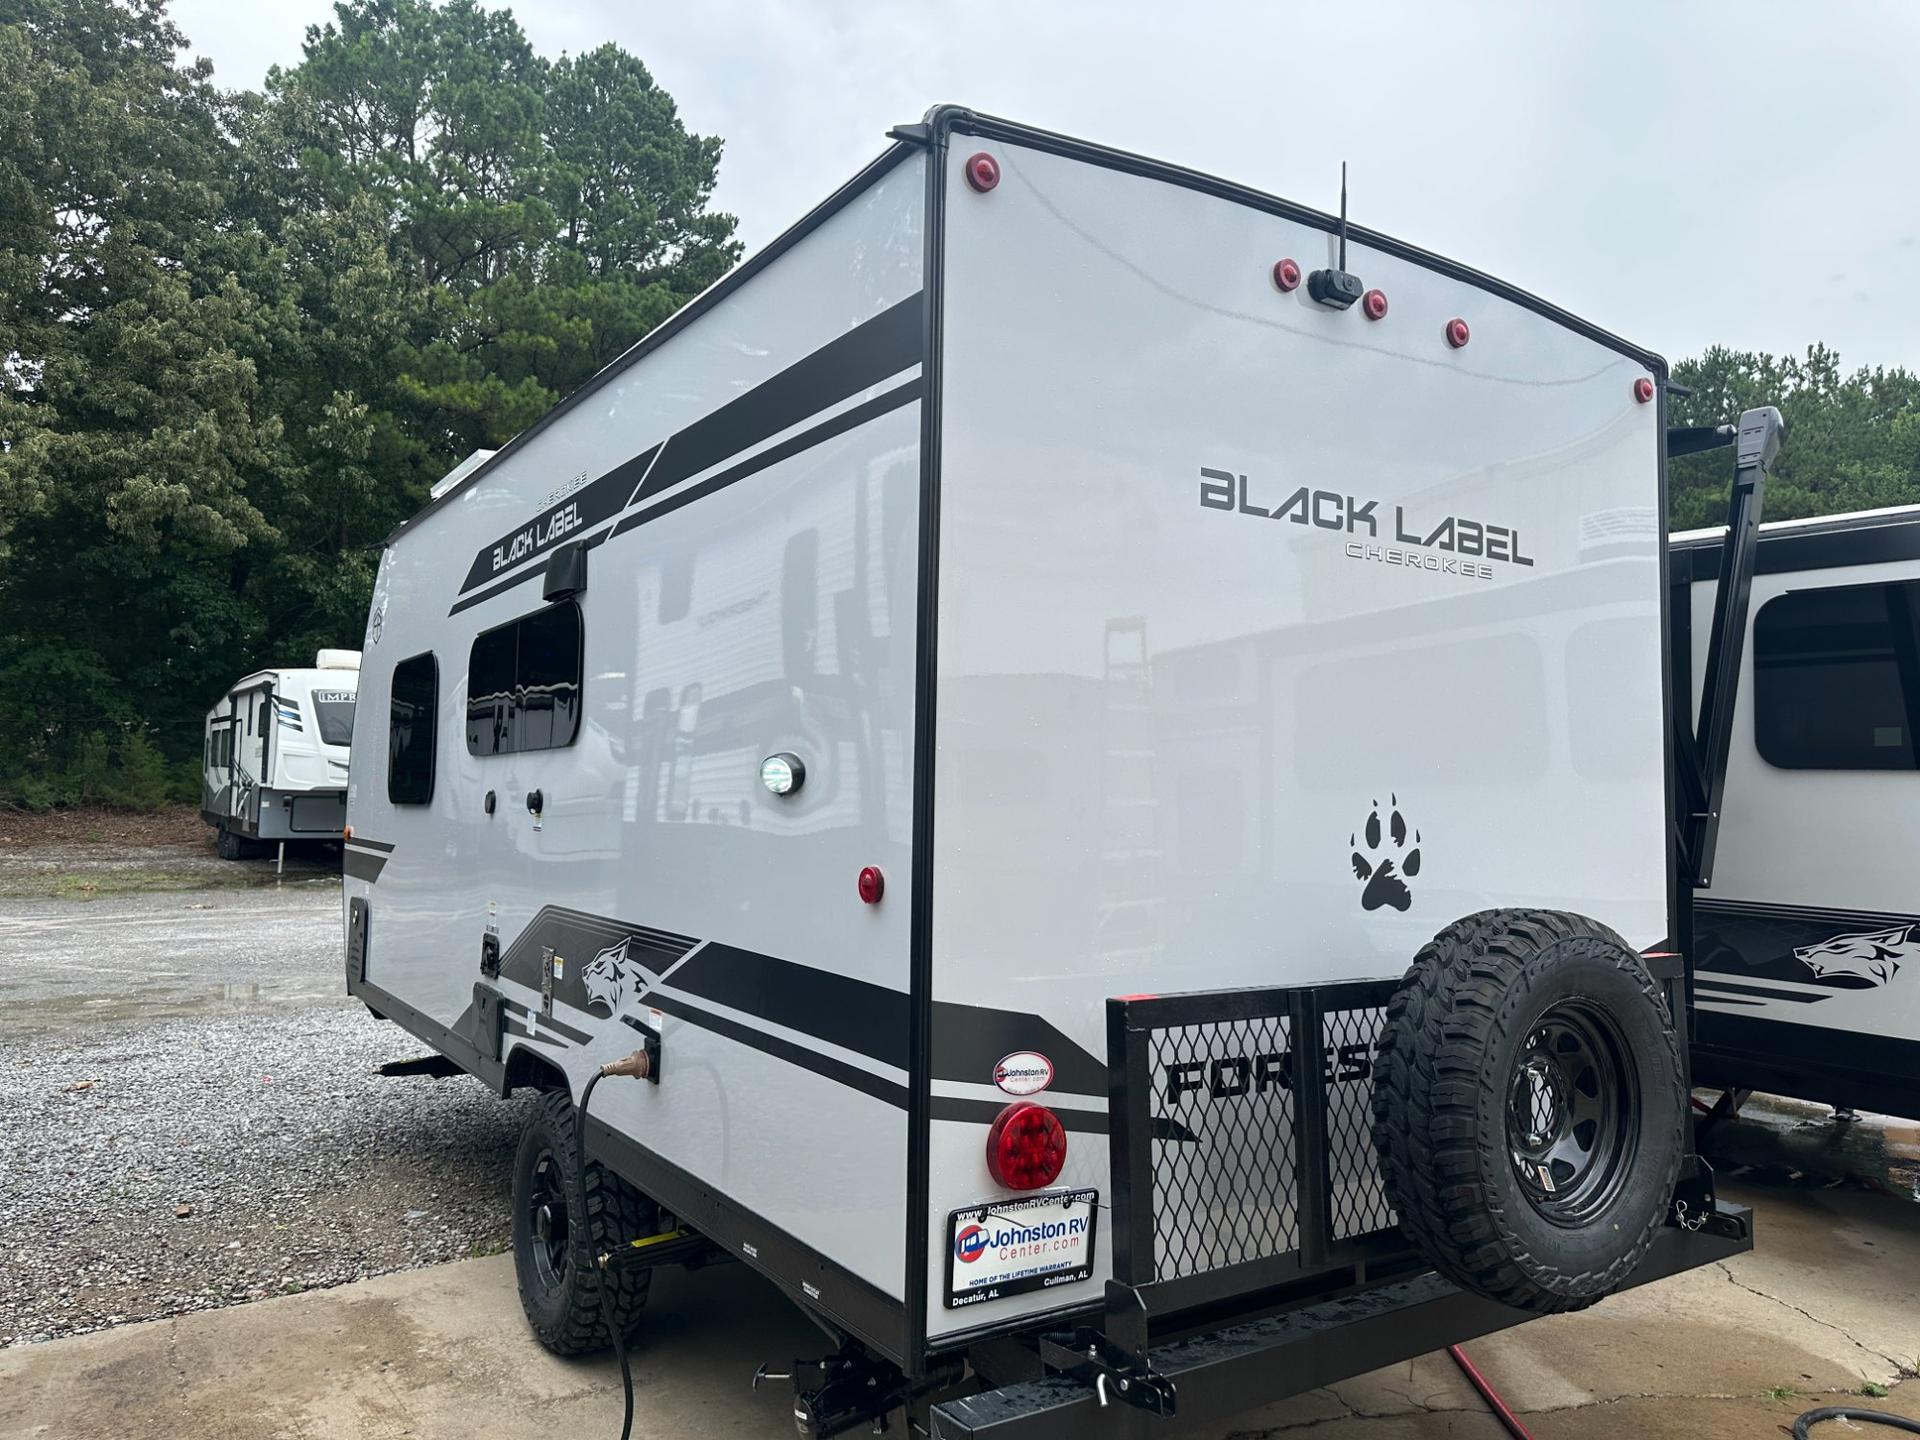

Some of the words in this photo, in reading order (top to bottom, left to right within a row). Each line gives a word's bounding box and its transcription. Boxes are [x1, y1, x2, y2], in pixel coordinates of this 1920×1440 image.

[536, 471, 587, 512] CHEROKEE
[1200, 466, 1379, 538] BLACK
[1396, 505, 1534, 567] LABEL
[493, 527, 533, 571] BLACK
[537, 502, 583, 547] LABEL
[1345, 542, 1494, 580] CHEROKEE
[1007, 1068, 1039, 1077] Johnston
[1165, 1043, 1379, 1104] FORS
[957, 1191, 1095, 1221] wwwJohnstonRVCente.com
[990, 1221, 1066, 1249] Johnston
[1069, 1216, 1089, 1234] RV
[999, 1236, 1079, 1261] Center.com
[969, 1277, 988, 1287] HOME
[989, 1275, 998, 1283] OF
[999, 1272, 1011, 1281] THE
[1011, 1267, 1039, 1278] LIFETIME
[1039, 1260, 1073, 1273] WARRANTY
[1078, 1270, 1089, 1280] AL
[988, 1289, 999, 1299] AL
